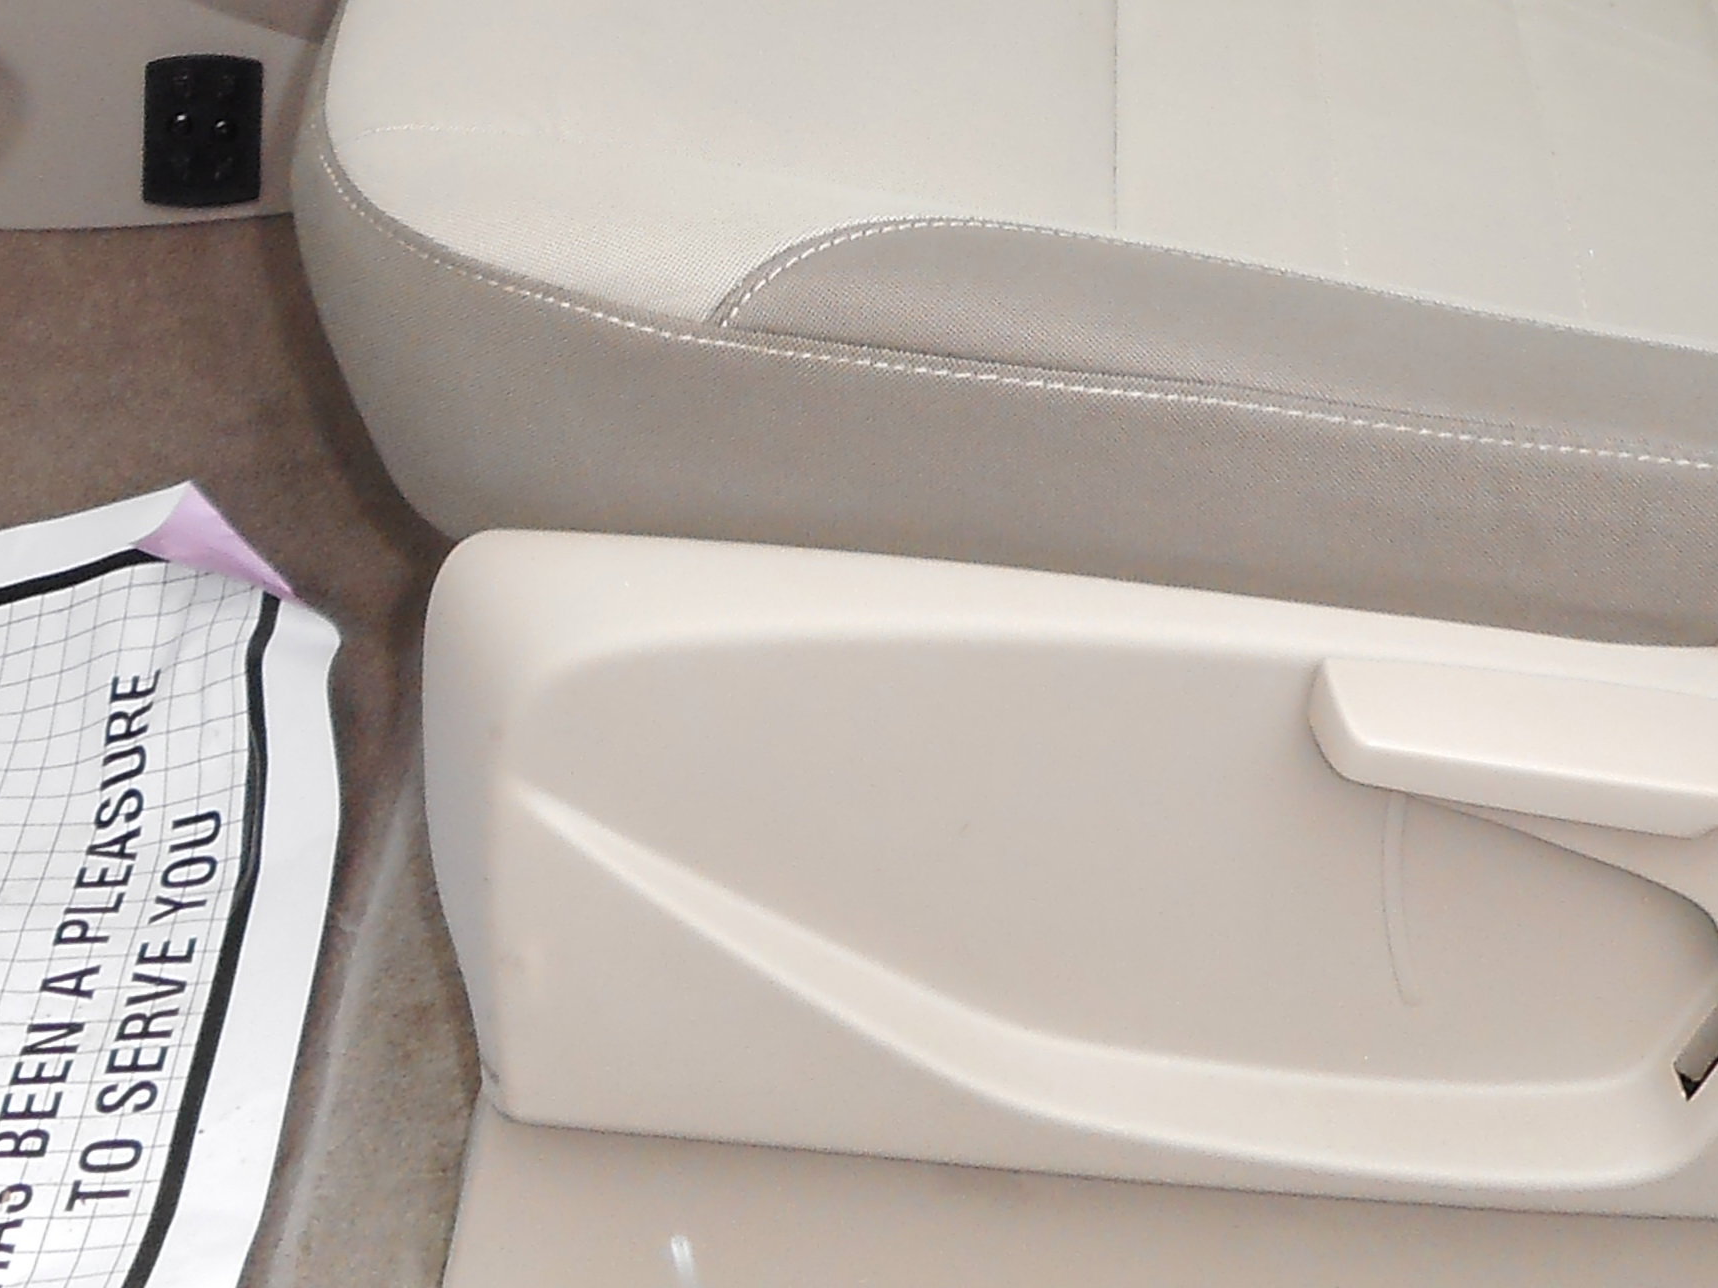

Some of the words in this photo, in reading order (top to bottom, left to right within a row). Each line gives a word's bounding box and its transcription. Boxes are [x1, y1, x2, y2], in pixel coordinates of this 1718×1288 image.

[54, 668, 161, 946] PLEASURE
[149, 810, 221, 925] YOU
[41, 964, 102, 999] A
[95, 937, 197, 1115] SERVE
[65, 1139, 143, 1212] TO
